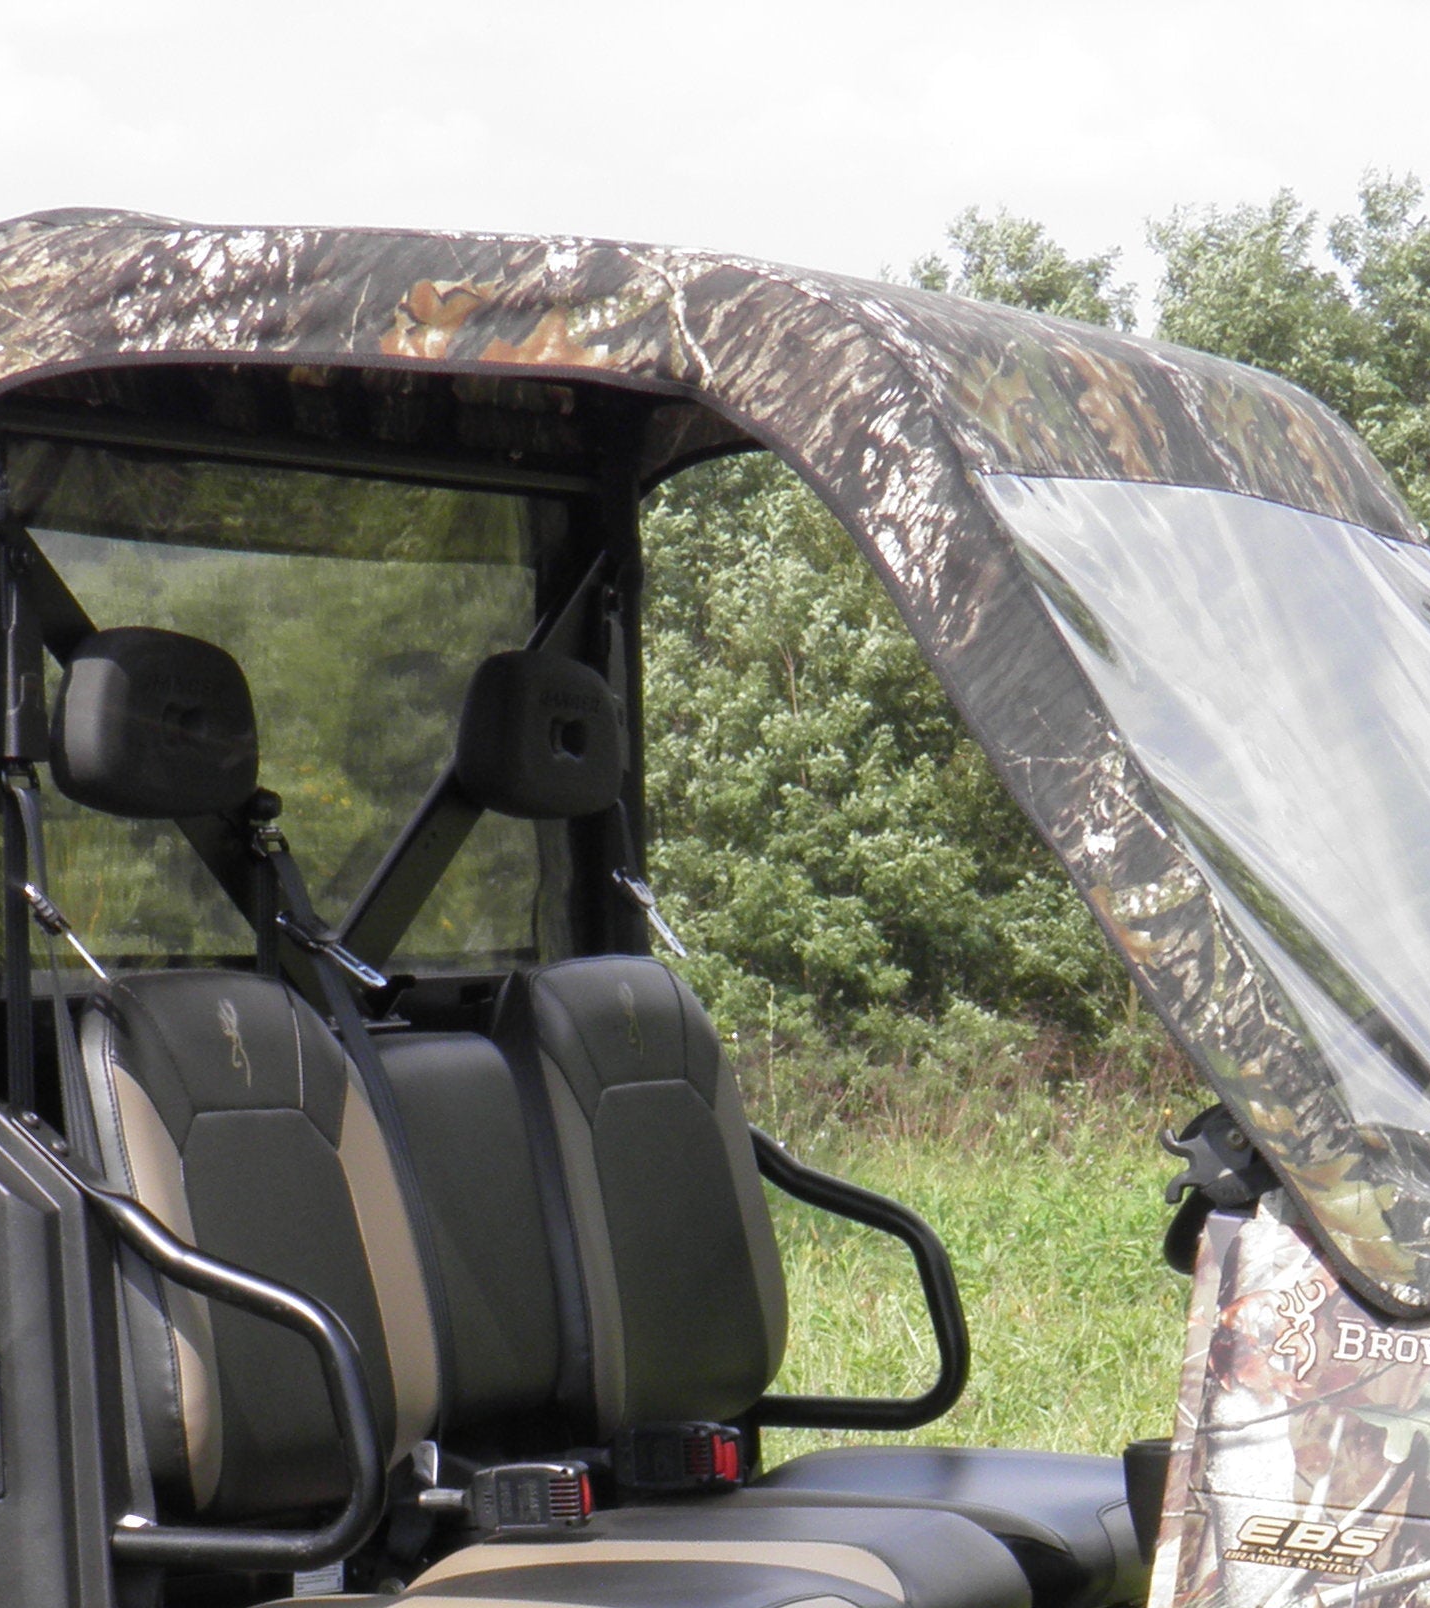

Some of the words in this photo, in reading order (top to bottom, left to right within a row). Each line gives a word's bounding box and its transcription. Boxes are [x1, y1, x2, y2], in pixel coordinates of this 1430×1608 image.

[1236, 1515, 1388, 1557] EBS
[1223, 1550, 1294, 1567] BRAKING
[1295, 1558, 1362, 1576] SYSTEM
